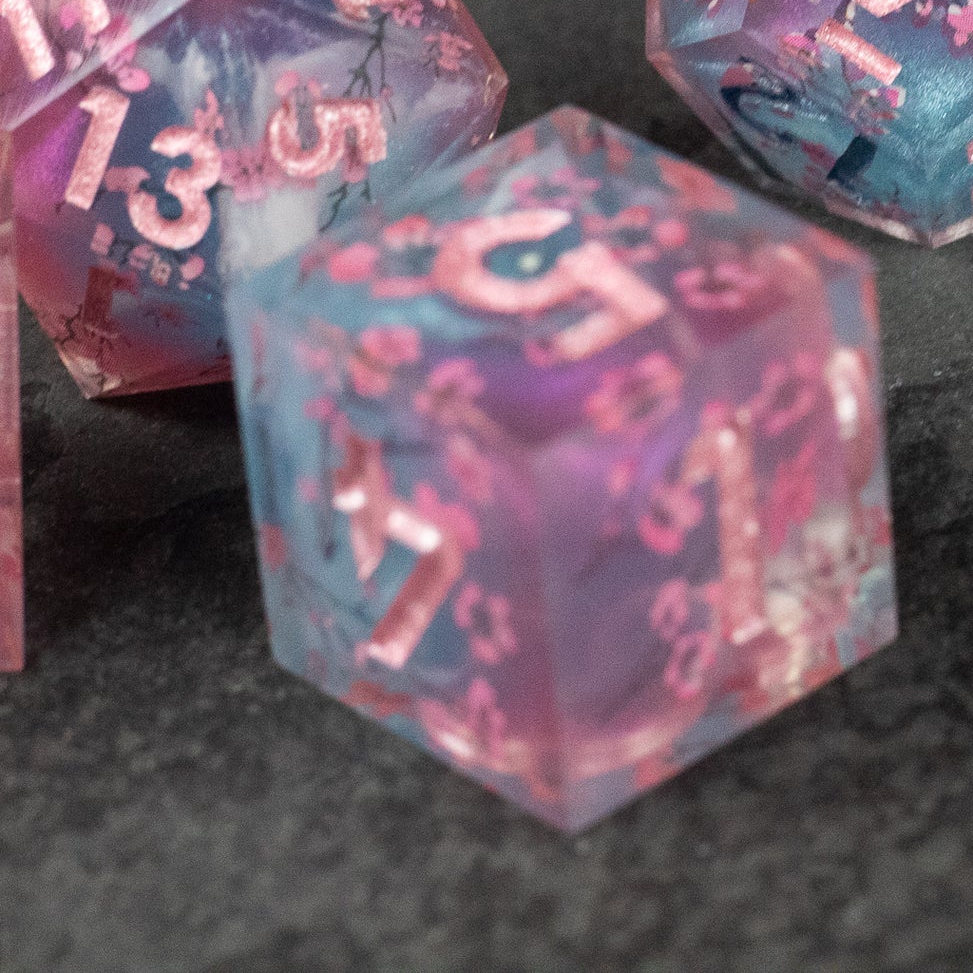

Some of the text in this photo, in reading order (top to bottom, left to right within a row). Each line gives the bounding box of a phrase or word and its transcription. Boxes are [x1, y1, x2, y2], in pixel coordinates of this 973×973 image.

[65, 87, 222, 249] 13
[268, 98, 388, 180] 5
[432, 210, 668, 359] 5
